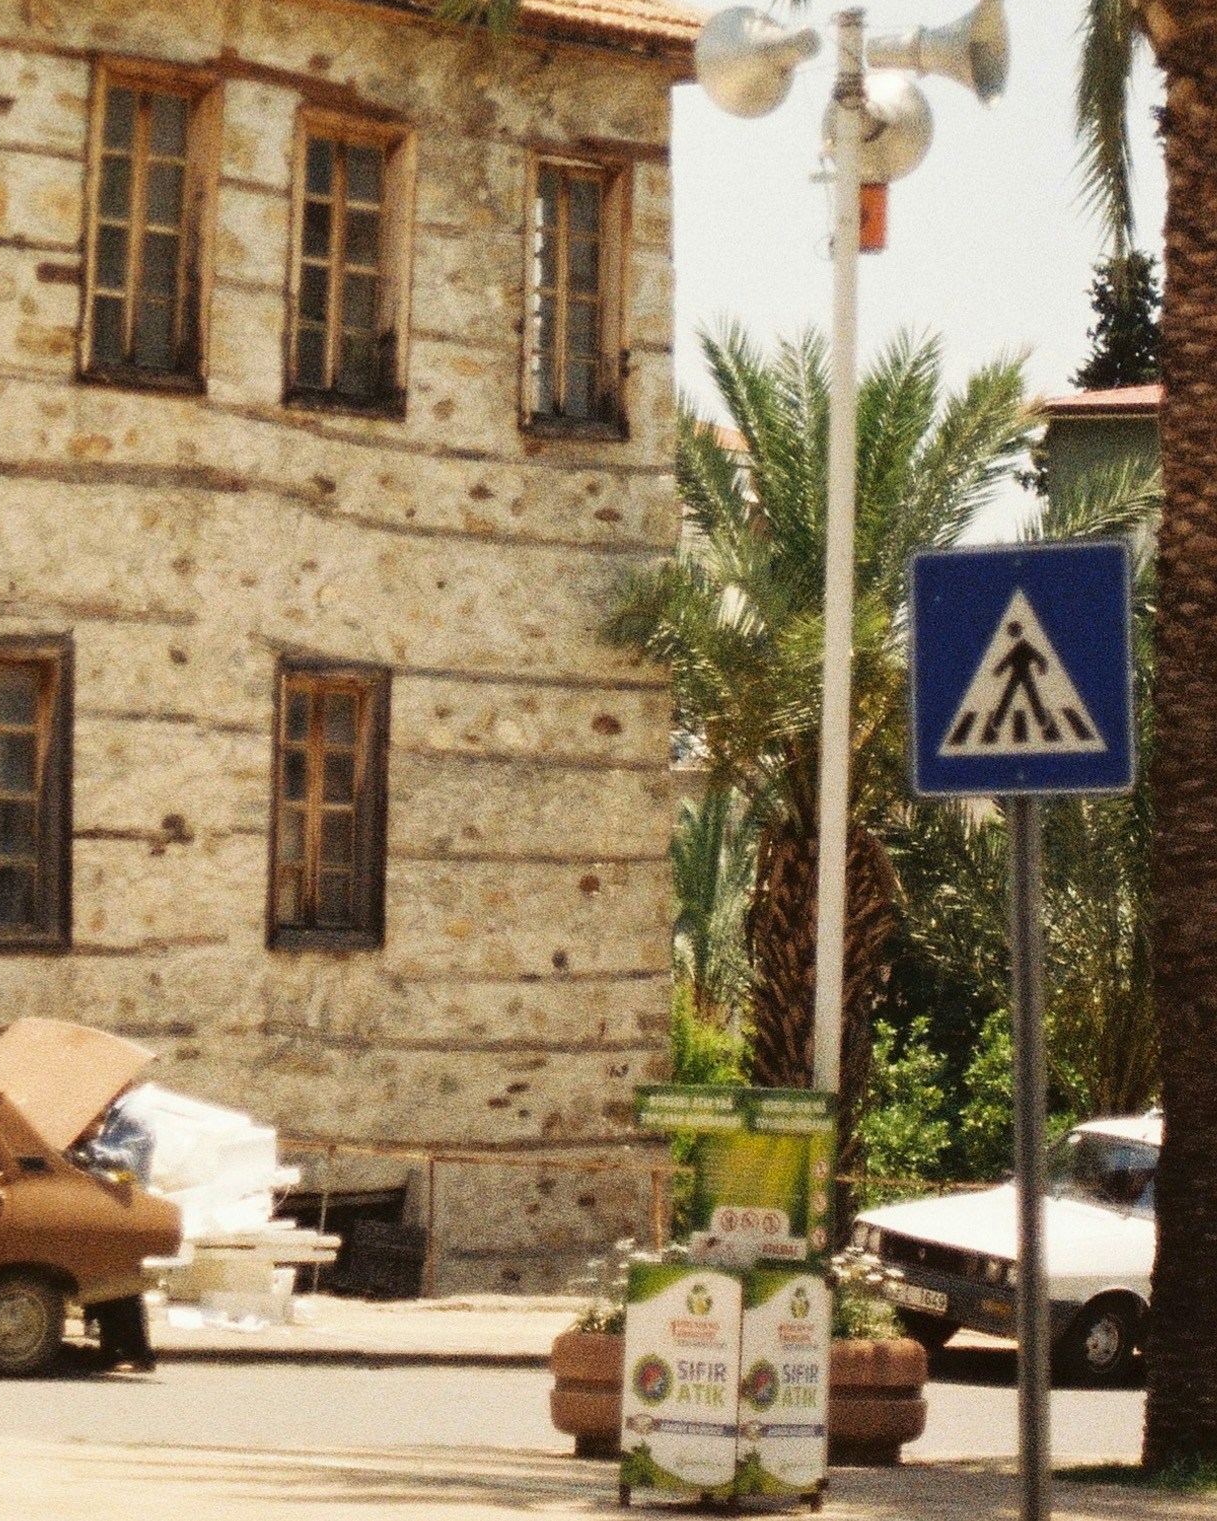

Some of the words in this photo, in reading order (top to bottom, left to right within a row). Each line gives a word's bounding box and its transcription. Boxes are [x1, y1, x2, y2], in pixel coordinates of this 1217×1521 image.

[676, 1358, 727, 1383] SIFIR
[781, 1362, 819, 1384] SIFIR
[675, 1383, 726, 1406] ATIK
[781, 1385, 818, 1407] ATIK
